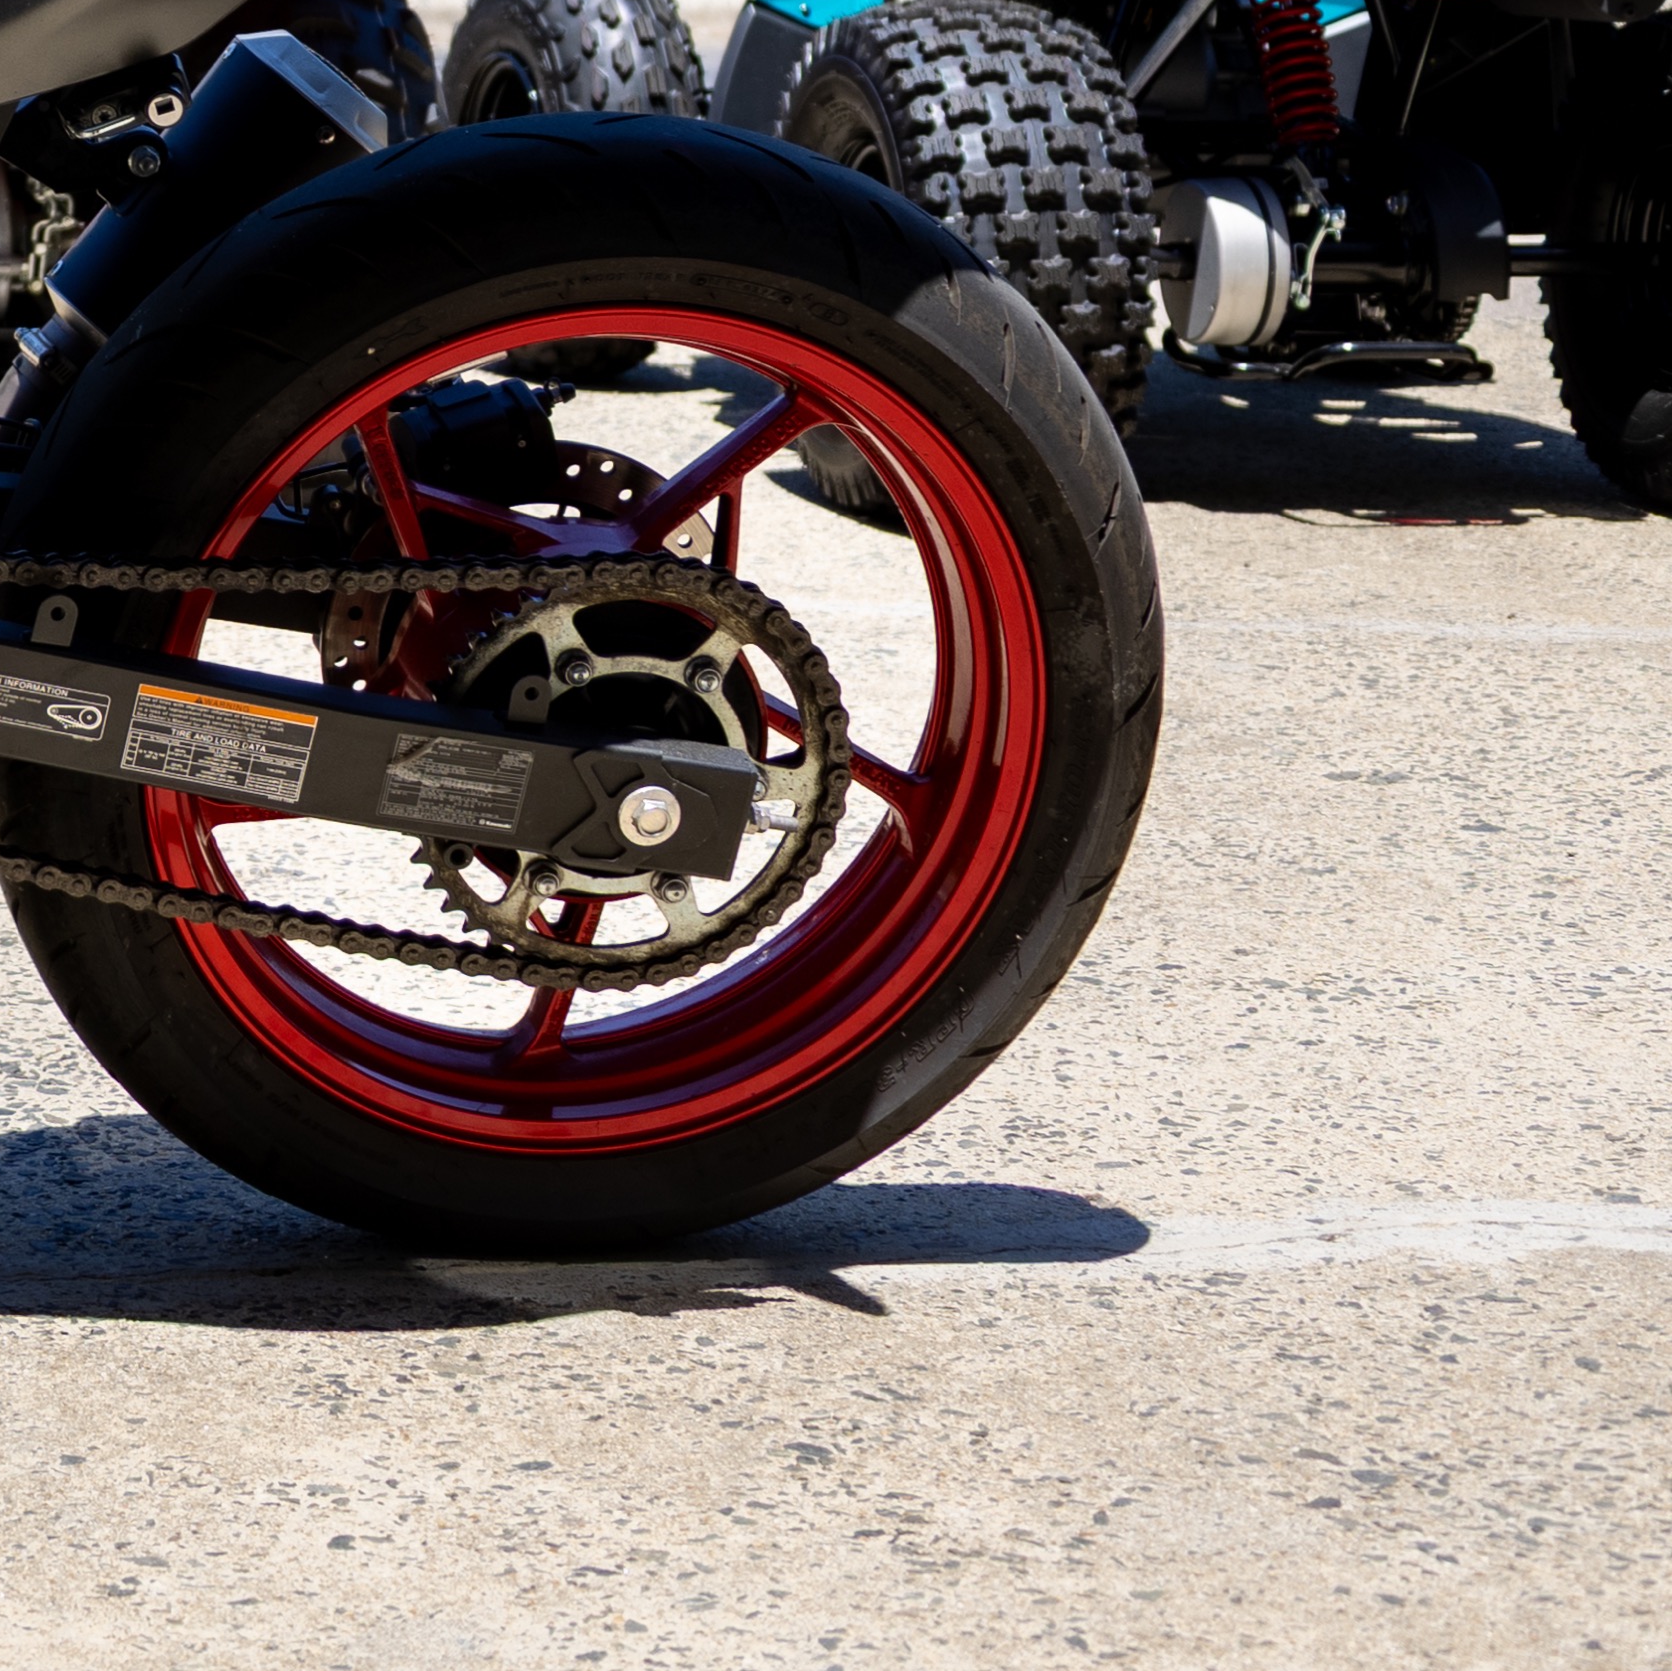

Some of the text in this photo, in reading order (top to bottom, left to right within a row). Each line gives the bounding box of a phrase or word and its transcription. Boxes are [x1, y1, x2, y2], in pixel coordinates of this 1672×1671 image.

[3, 678, 69, 697] INFORMATION
[201, 697, 250, 713] WARNING
[170, 728, 267, 753] TIRE AND LOAD DATA
